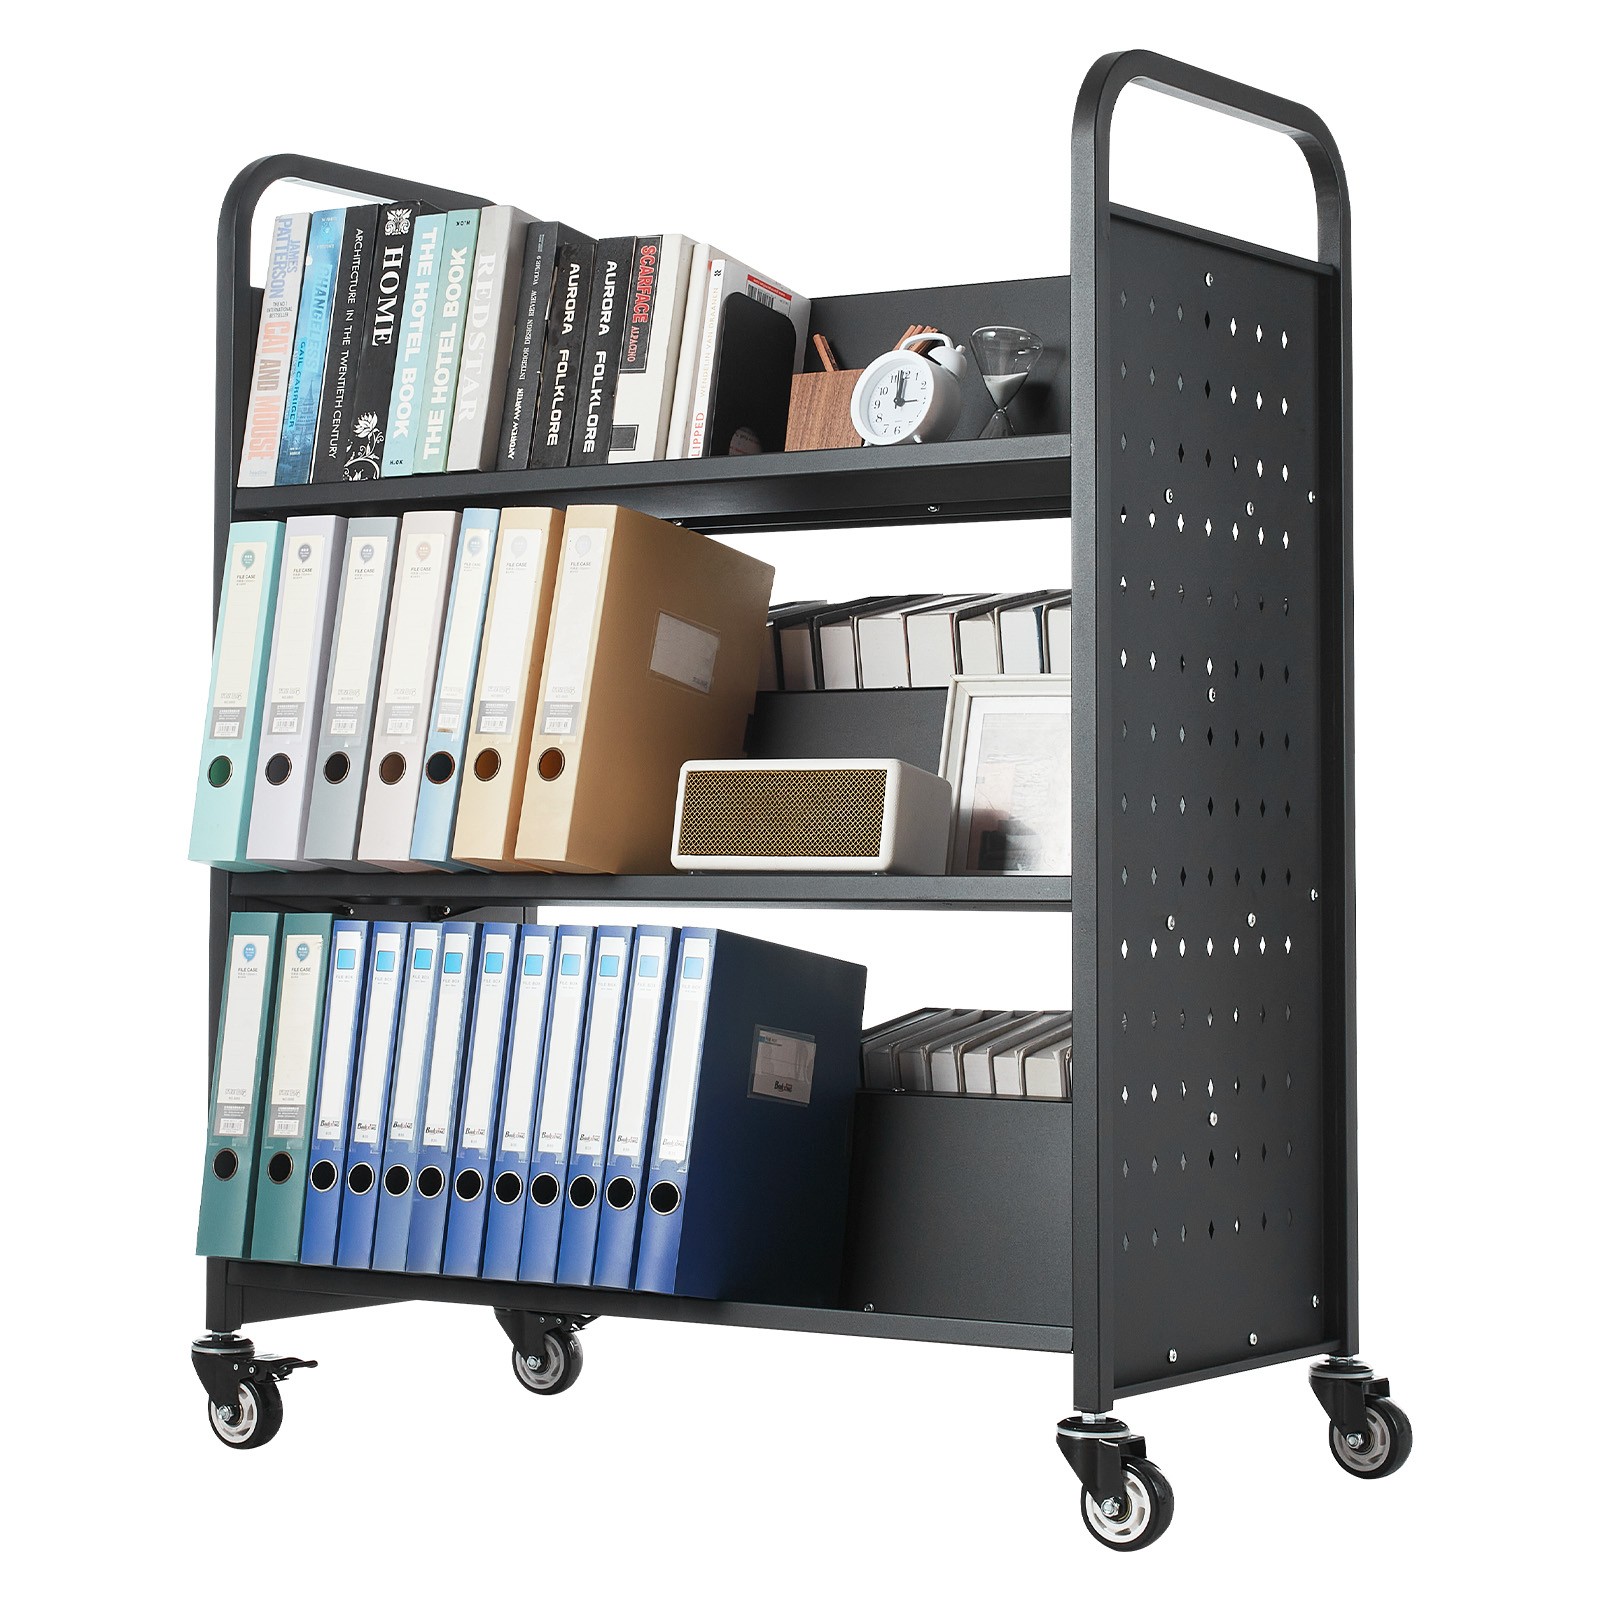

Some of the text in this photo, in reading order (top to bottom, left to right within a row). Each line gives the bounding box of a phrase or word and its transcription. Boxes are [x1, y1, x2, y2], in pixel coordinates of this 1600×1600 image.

[268, 217, 293, 299] PATTERSON
[287, 240, 301, 273] JAMES
[533, 260, 541, 286] VOLUME
[631, 245, 657, 324] SCARFACE
[372, 244, 404, 347] HOME
[261, 320, 291, 355] CAT
[297, 341, 306, 366] GAIL
[328, 228, 364, 459] ARCHITECTURE IN THE TWENTIETH CENTURY
[392, 227, 438, 439] THE HOTEL BOOK
[423, 246, 468, 460] THE HOTEL BOOK
[519, 289, 538, 380] INTERIOR DESIGN REVIEW
[546, 262, 580, 447] AURORA FOLKLORE
[582, 260, 618, 453] AURORA FOLKLORE
[699, 286, 719, 398] WENDELIN VAN DRAANEN
[256, 358, 282, 392] AND
[288, 371, 302, 428] CARRIGER
[879, 386, 889, 396] 10
[920, 382, 927, 390] 2
[248, 395, 282, 461] MOUSE
[508, 387, 524, 460] ANDREW MARTIN
[873, 400, 881, 410] 9
[875, 413, 883, 423] 8
[882, 424, 889, 435] 7
[893, 426, 901, 435] 6
[691, 411, 705, 457] LIPPED
